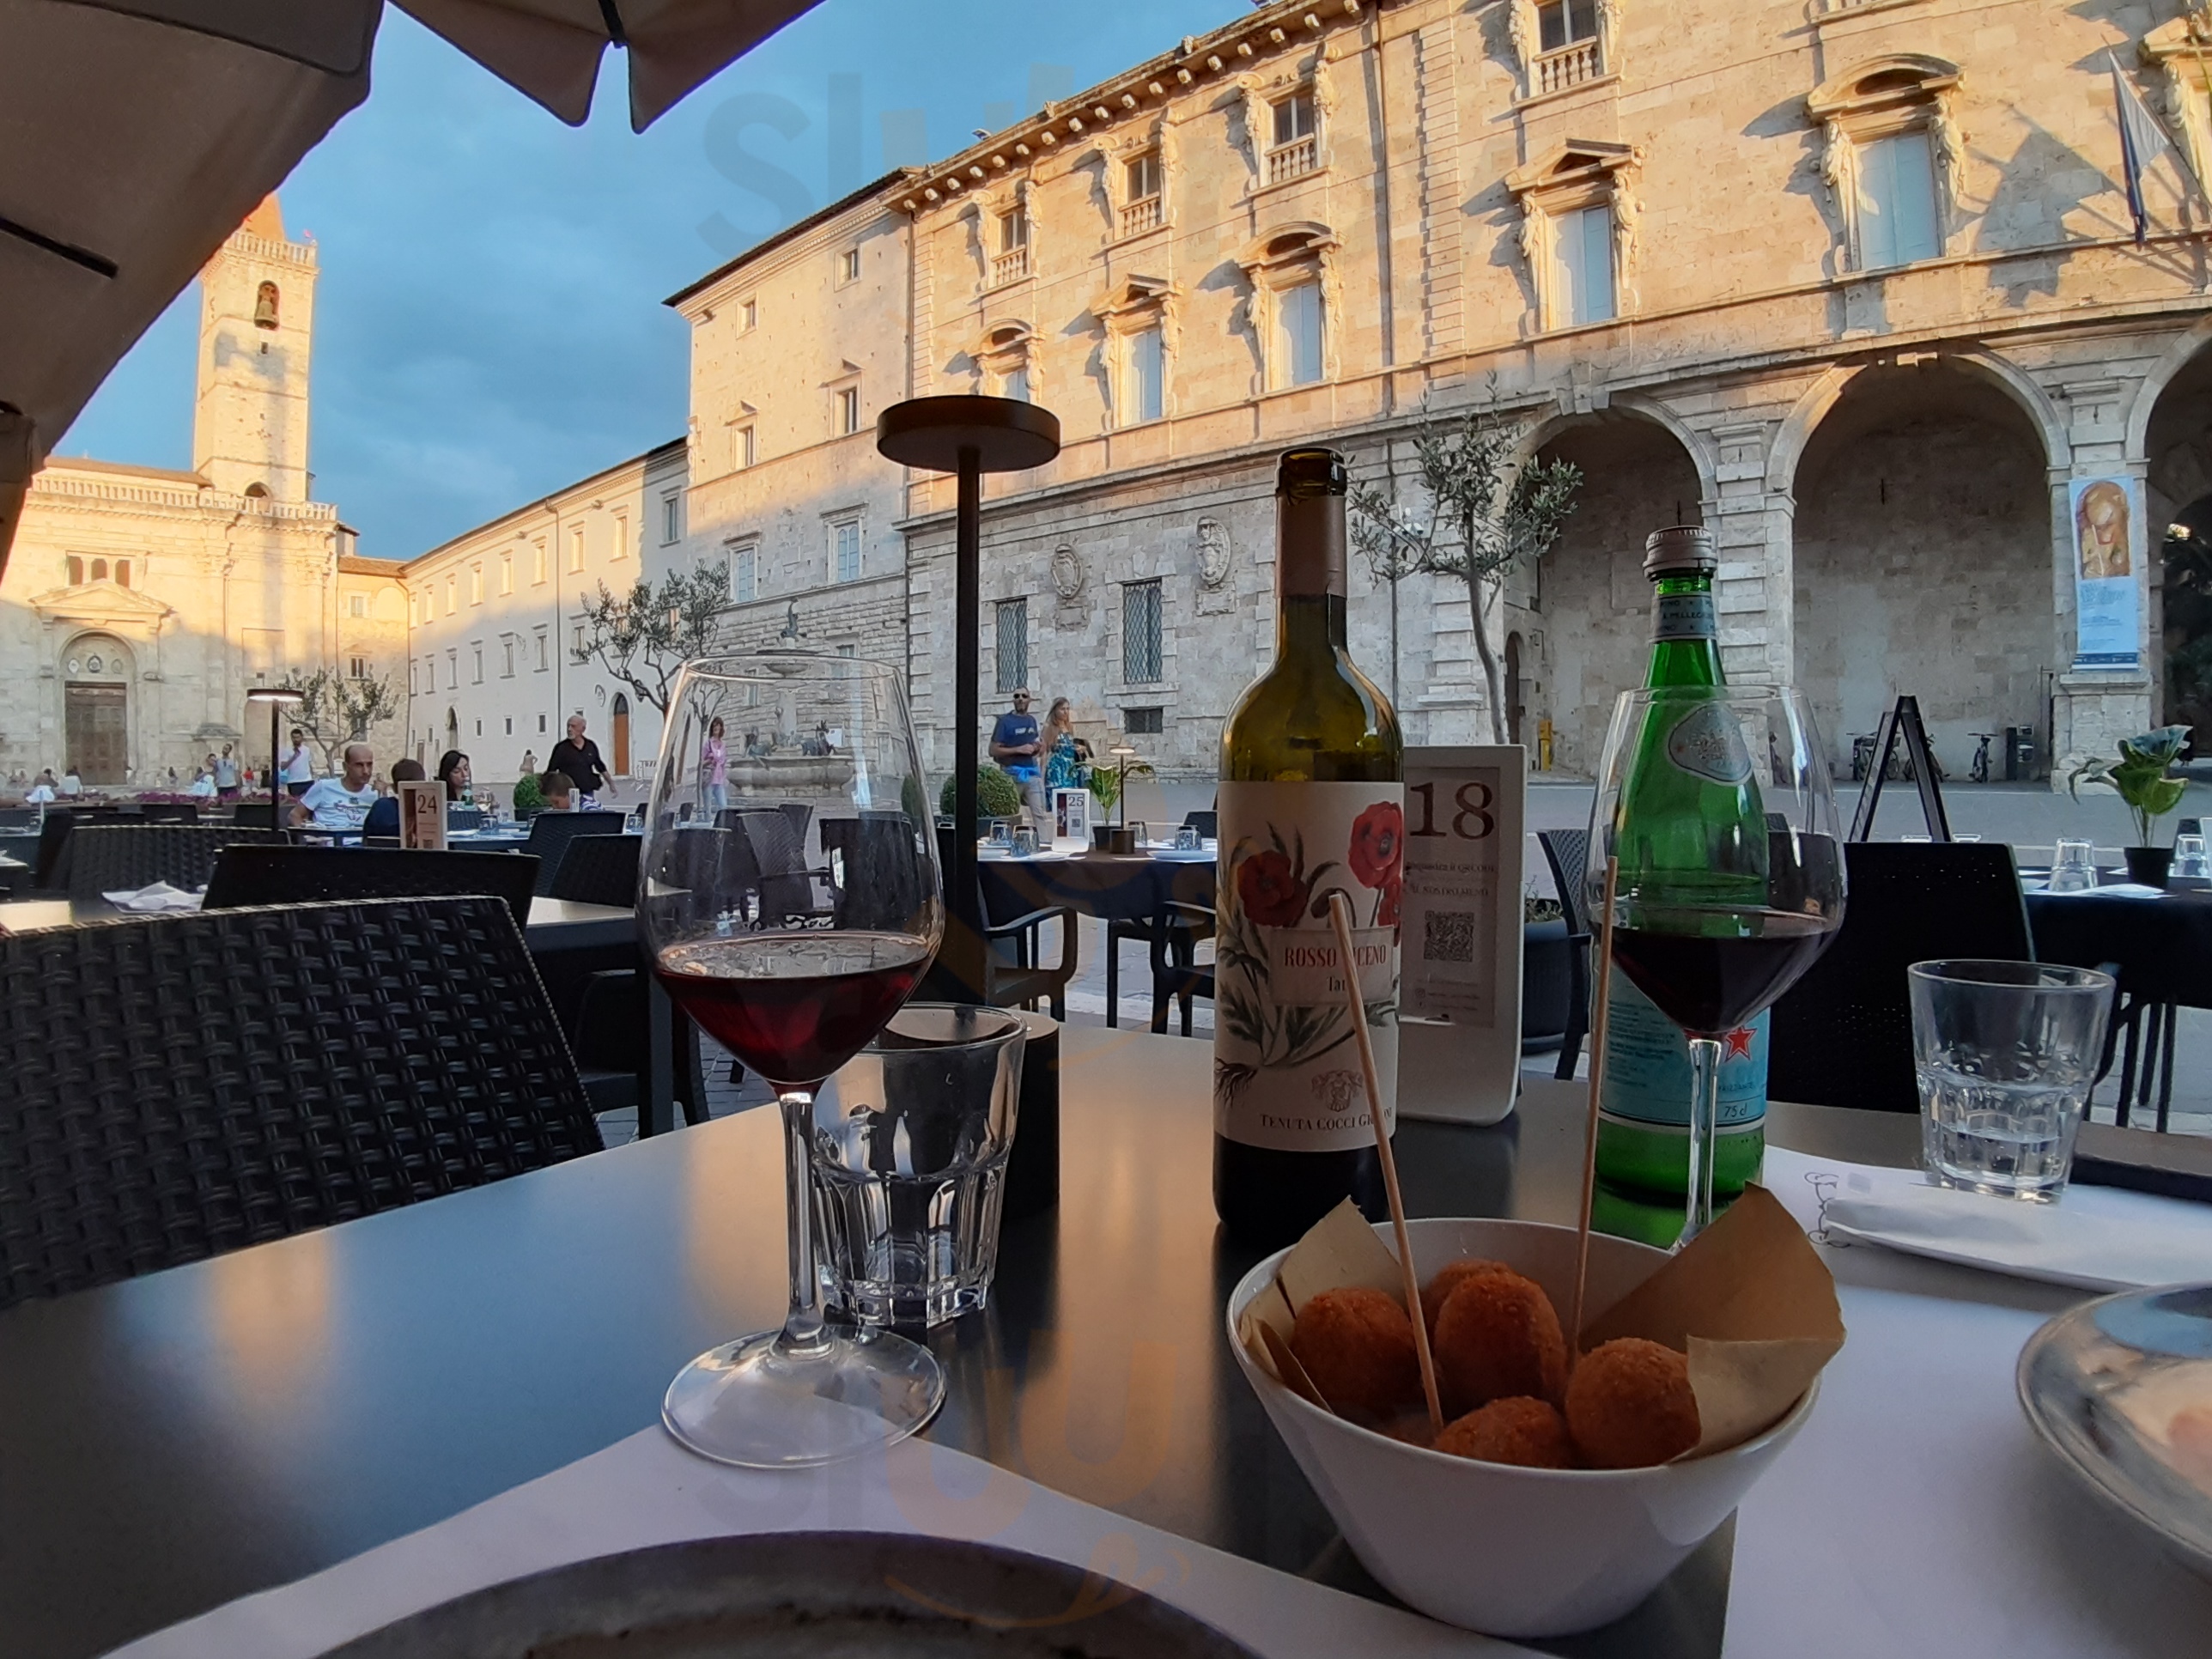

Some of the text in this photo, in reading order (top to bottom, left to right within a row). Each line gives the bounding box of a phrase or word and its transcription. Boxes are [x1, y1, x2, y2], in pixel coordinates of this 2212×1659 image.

[417, 794, 437, 814] 24
[1068, 796, 1084, 807] 25
[1409, 781, 1494, 840] 18
[1285, 945, 1387, 968] ROSSO ICENO
[1261, 1114, 1312, 1131] TENUTA
[1316, 1115, 1356, 1131] COCCI
